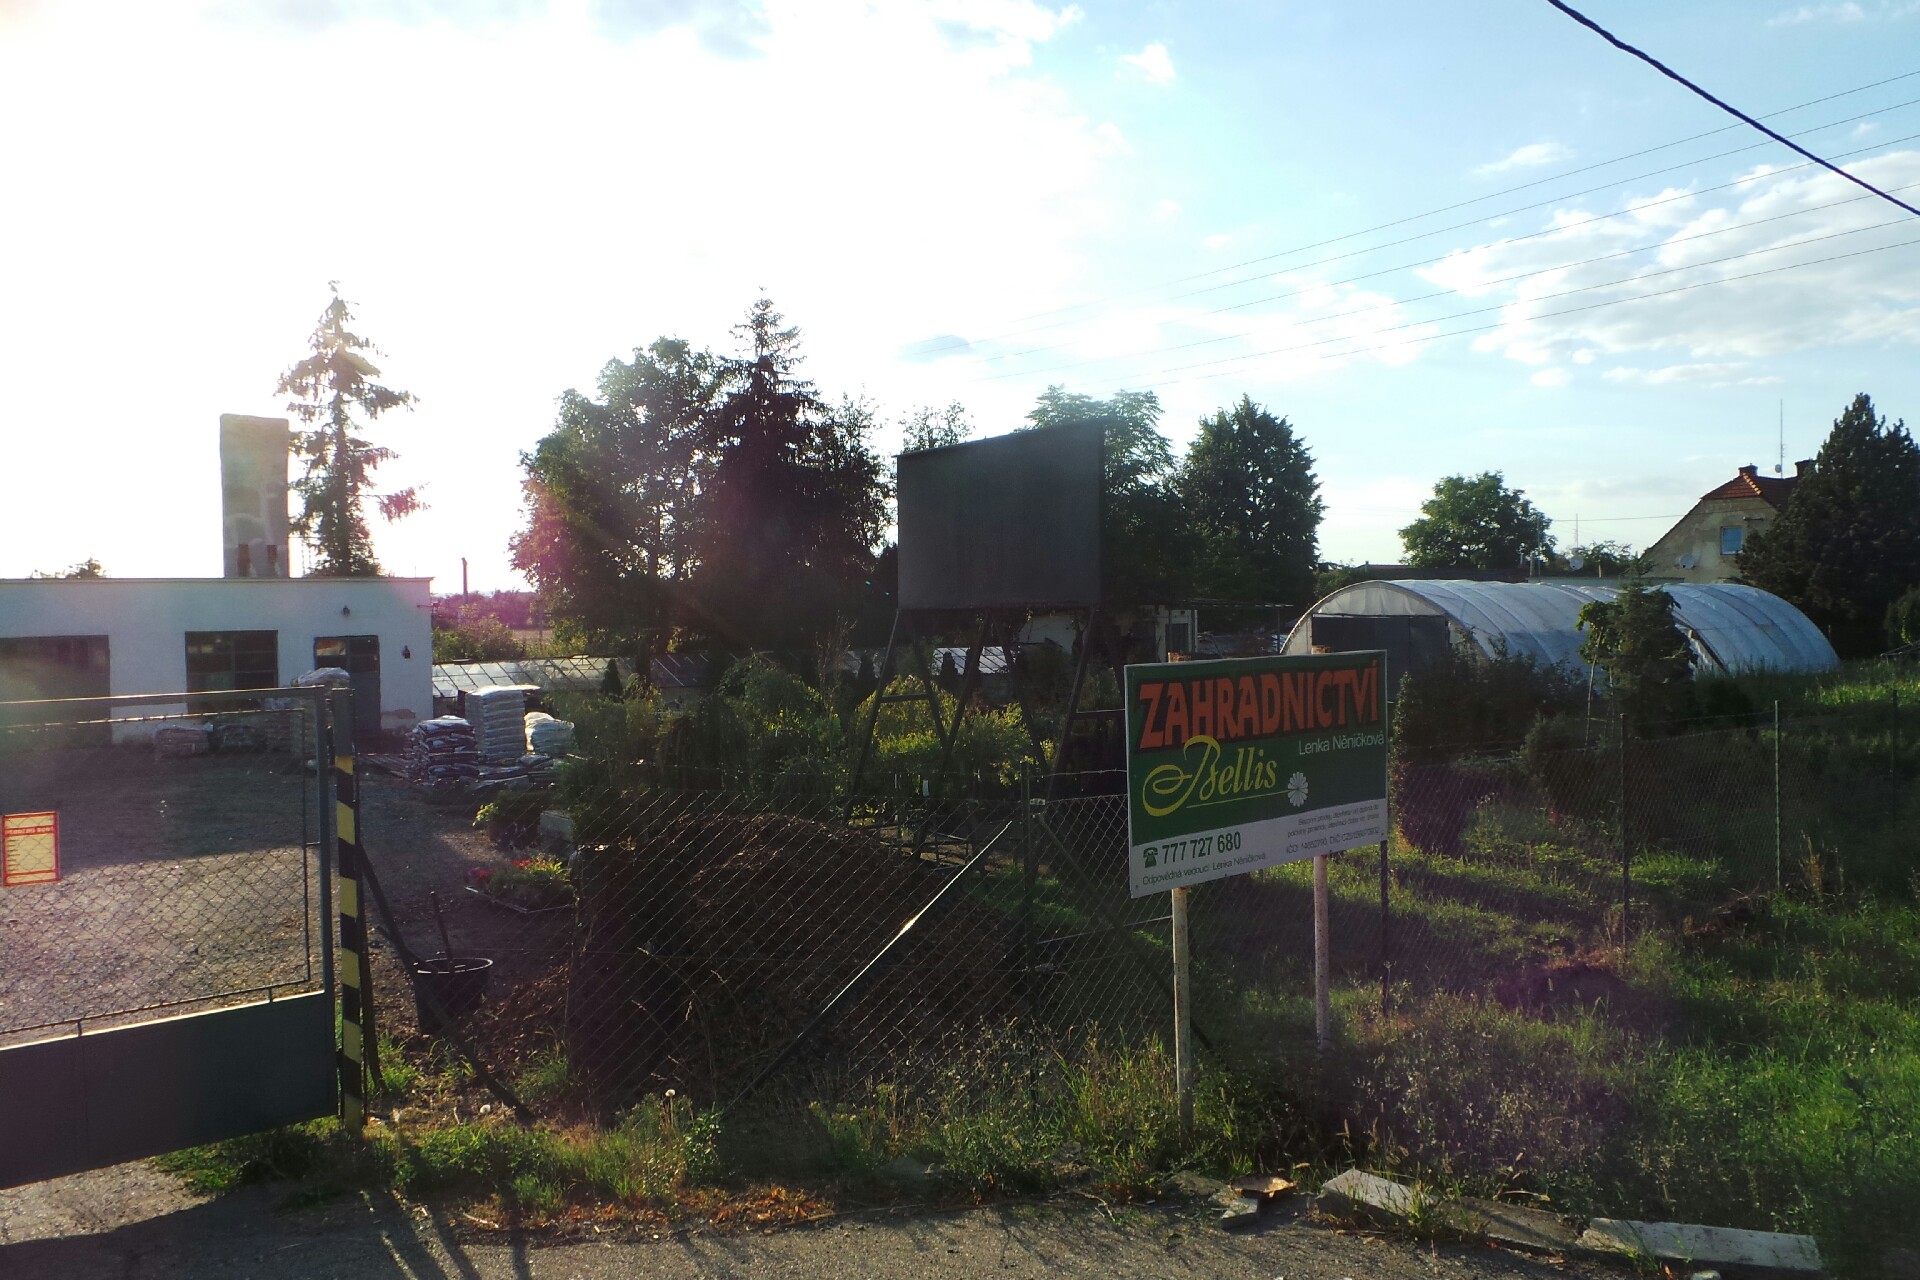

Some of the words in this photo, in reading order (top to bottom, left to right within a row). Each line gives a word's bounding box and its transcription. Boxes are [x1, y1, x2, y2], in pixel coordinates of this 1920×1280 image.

[1139, 659, 1378, 749] ZAHRADNICTVÍ
[1299, 737, 1330, 755] Lenka
[1332, 730, 1385, 751] Něničková
[1142, 735, 1277, 817] Bellis
[1162, 841, 1187, 864] 777
[1190, 836, 1213, 858] 727
[1217, 831, 1241, 853] 680
[1212, 860, 1232, 871] Lenka
